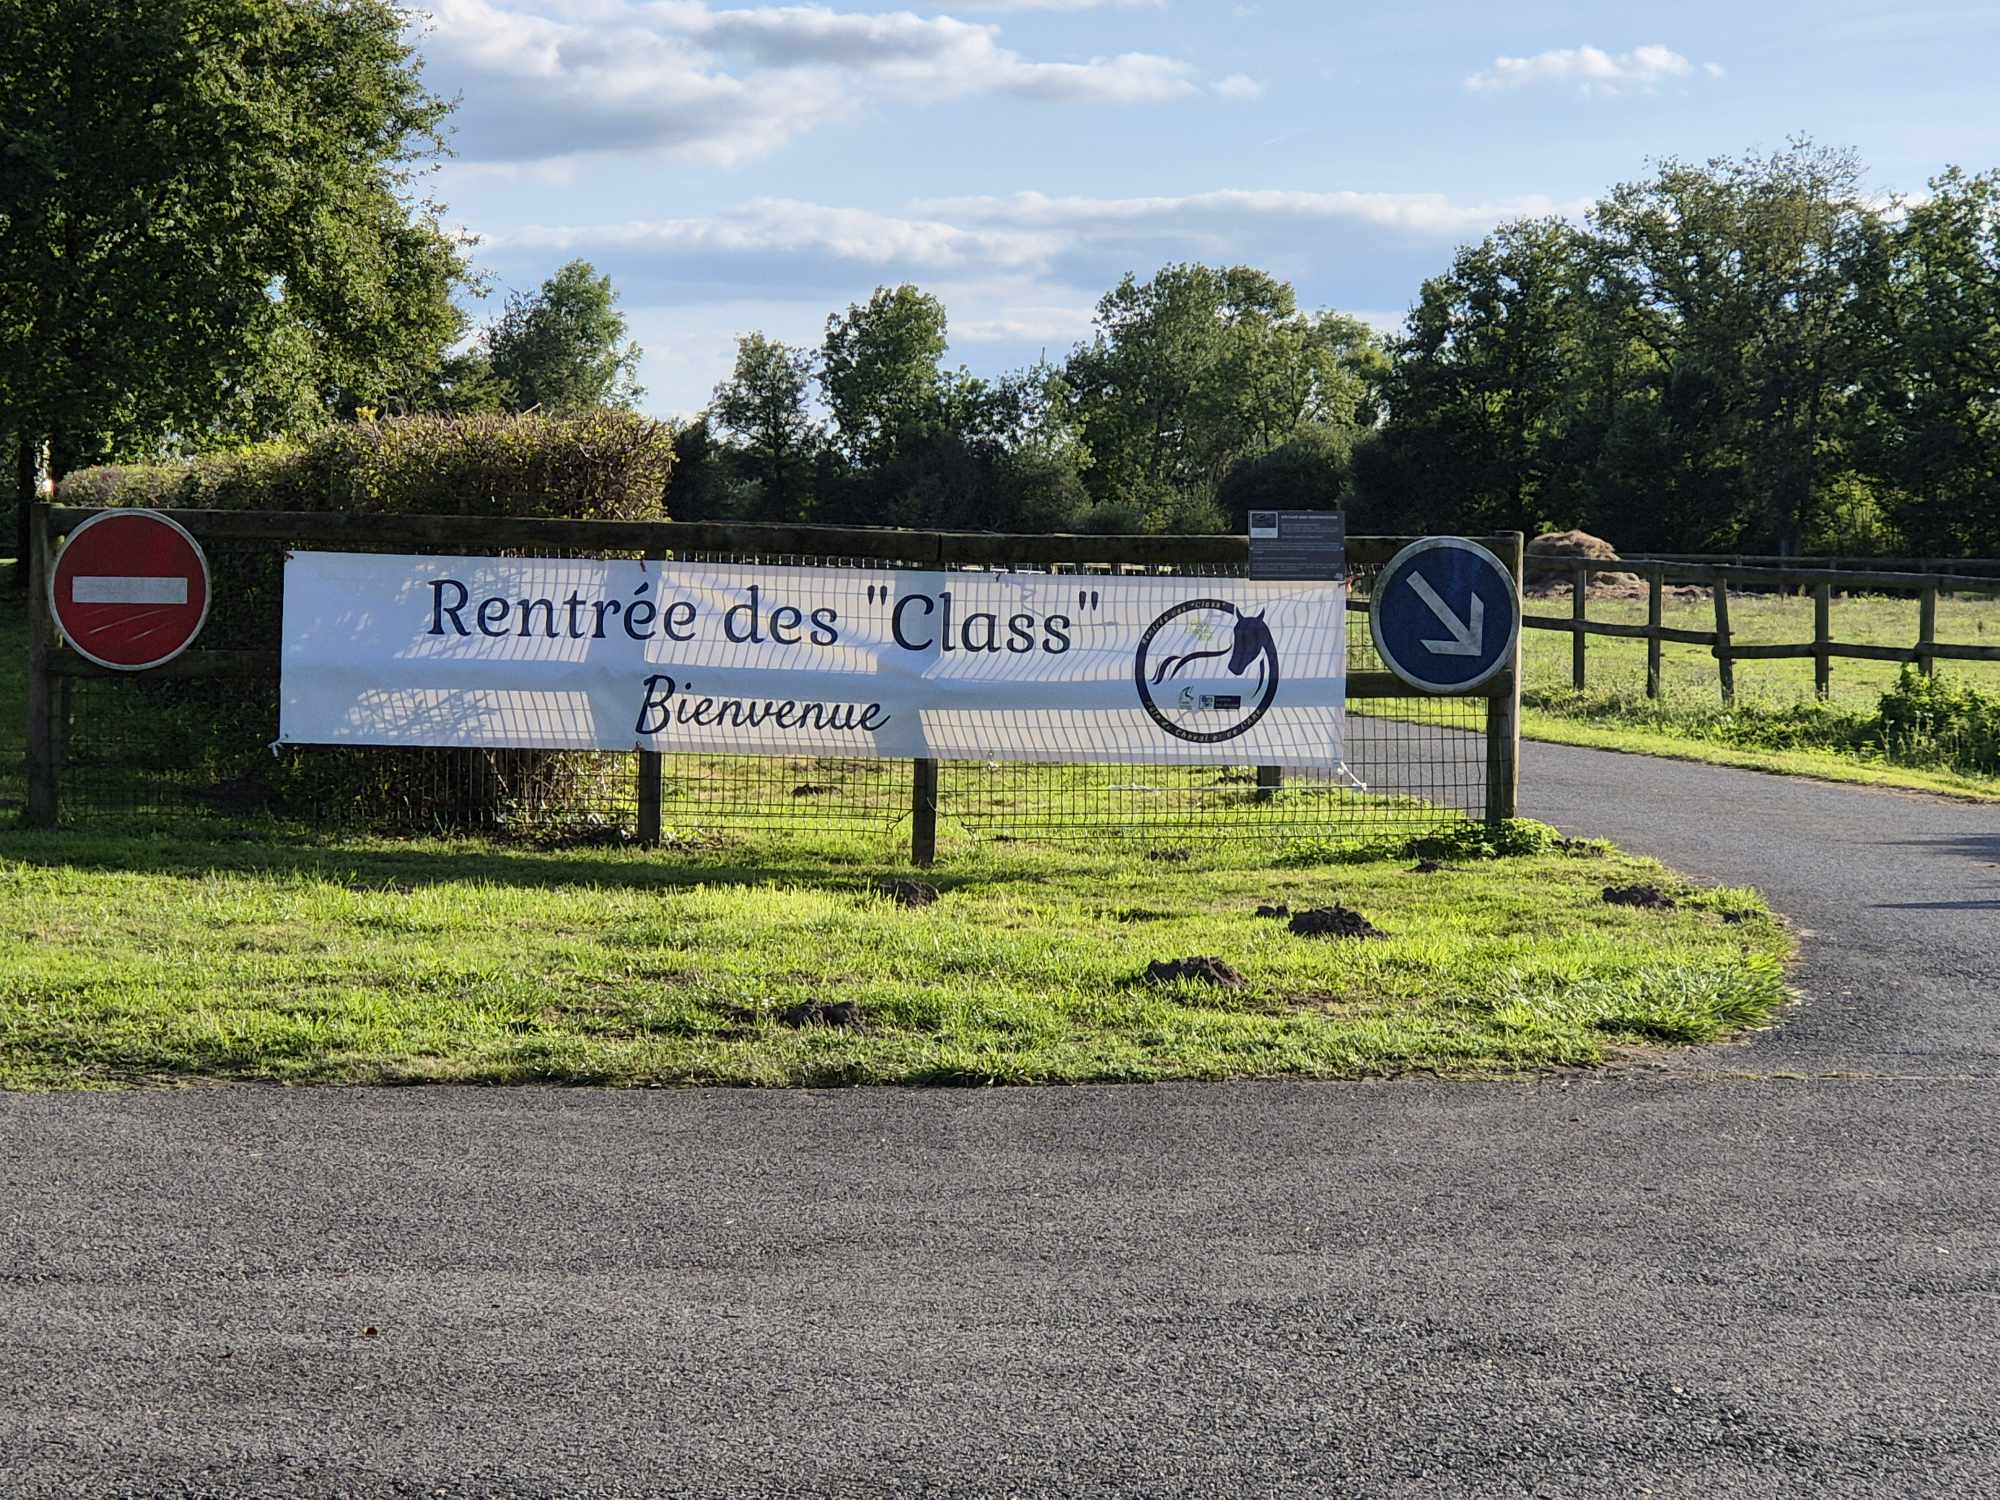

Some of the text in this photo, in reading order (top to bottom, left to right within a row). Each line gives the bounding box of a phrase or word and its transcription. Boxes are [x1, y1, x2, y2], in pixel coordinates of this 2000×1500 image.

[428, 580, 1099, 655] Rentrée des "Class"
[635, 675, 891, 735] Bienvenue
